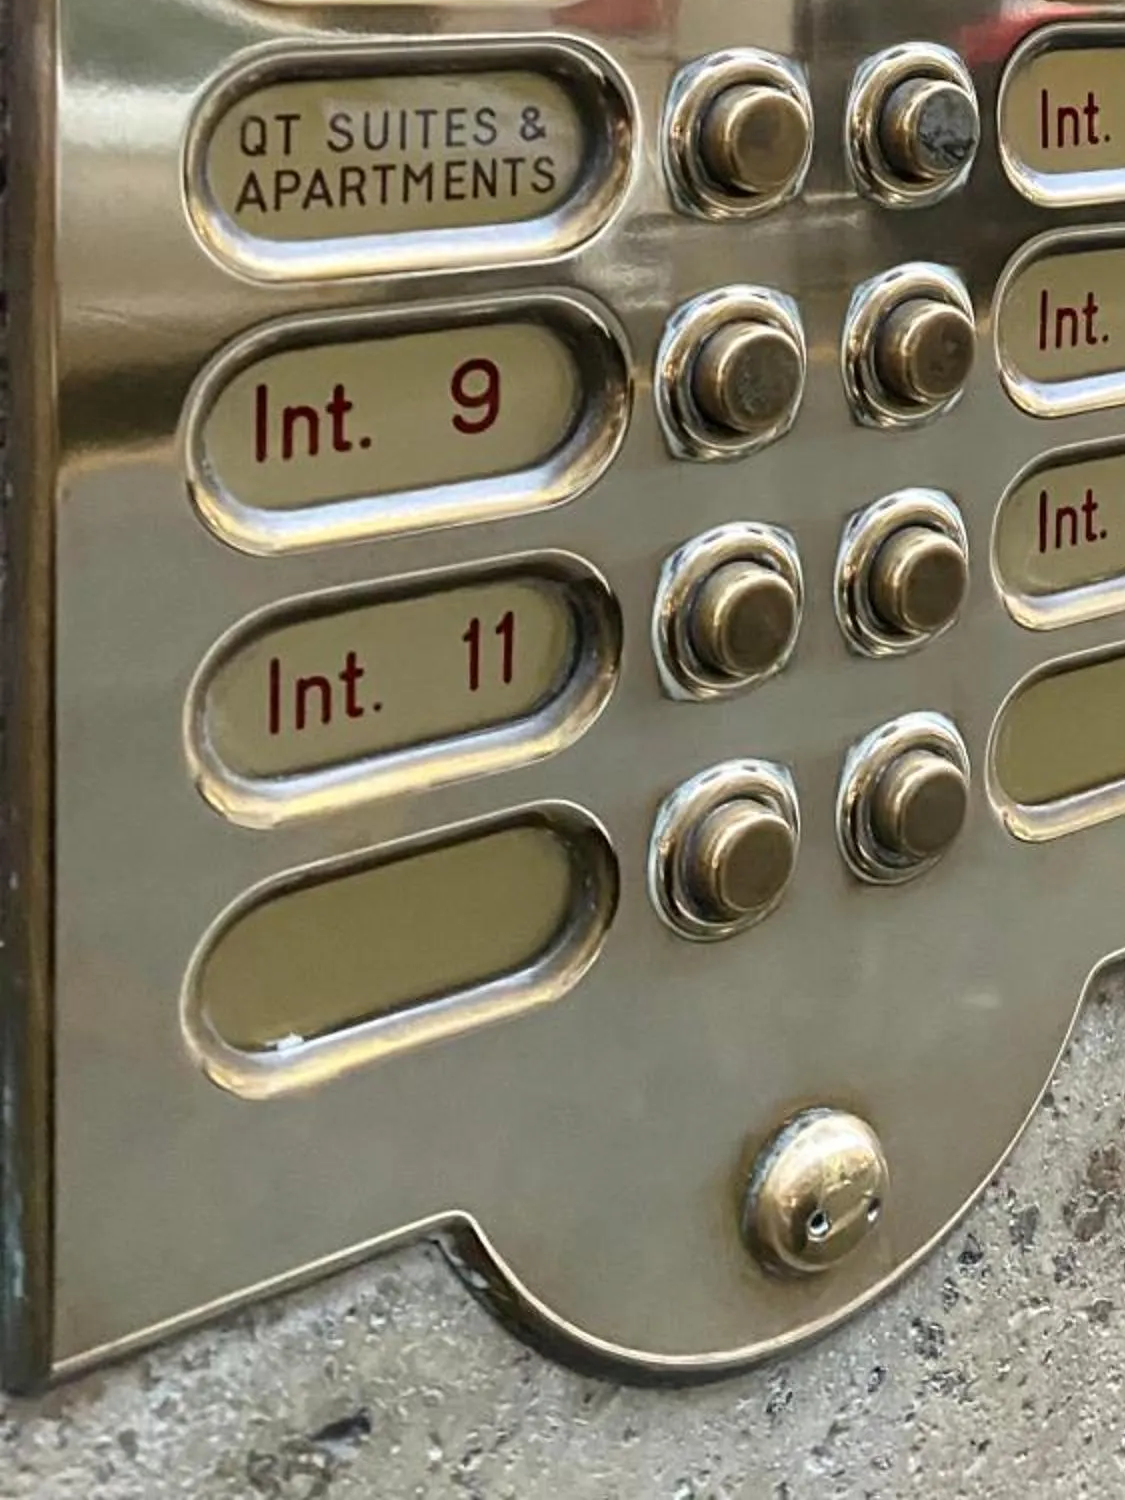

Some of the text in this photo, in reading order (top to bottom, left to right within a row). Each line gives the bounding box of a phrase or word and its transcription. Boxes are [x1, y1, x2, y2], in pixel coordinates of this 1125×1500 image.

[240, 105, 547, 157] QT SUITES &
[1040, 88, 1111, 149] Int.
[235, 156, 555, 214] APARTMENTS
[1039, 290, 1108, 350] Int.
[255, 358, 501, 463] Int. 9
[1039, 488, 1107, 553] Int.
[269, 610, 514, 735] Int. 11
